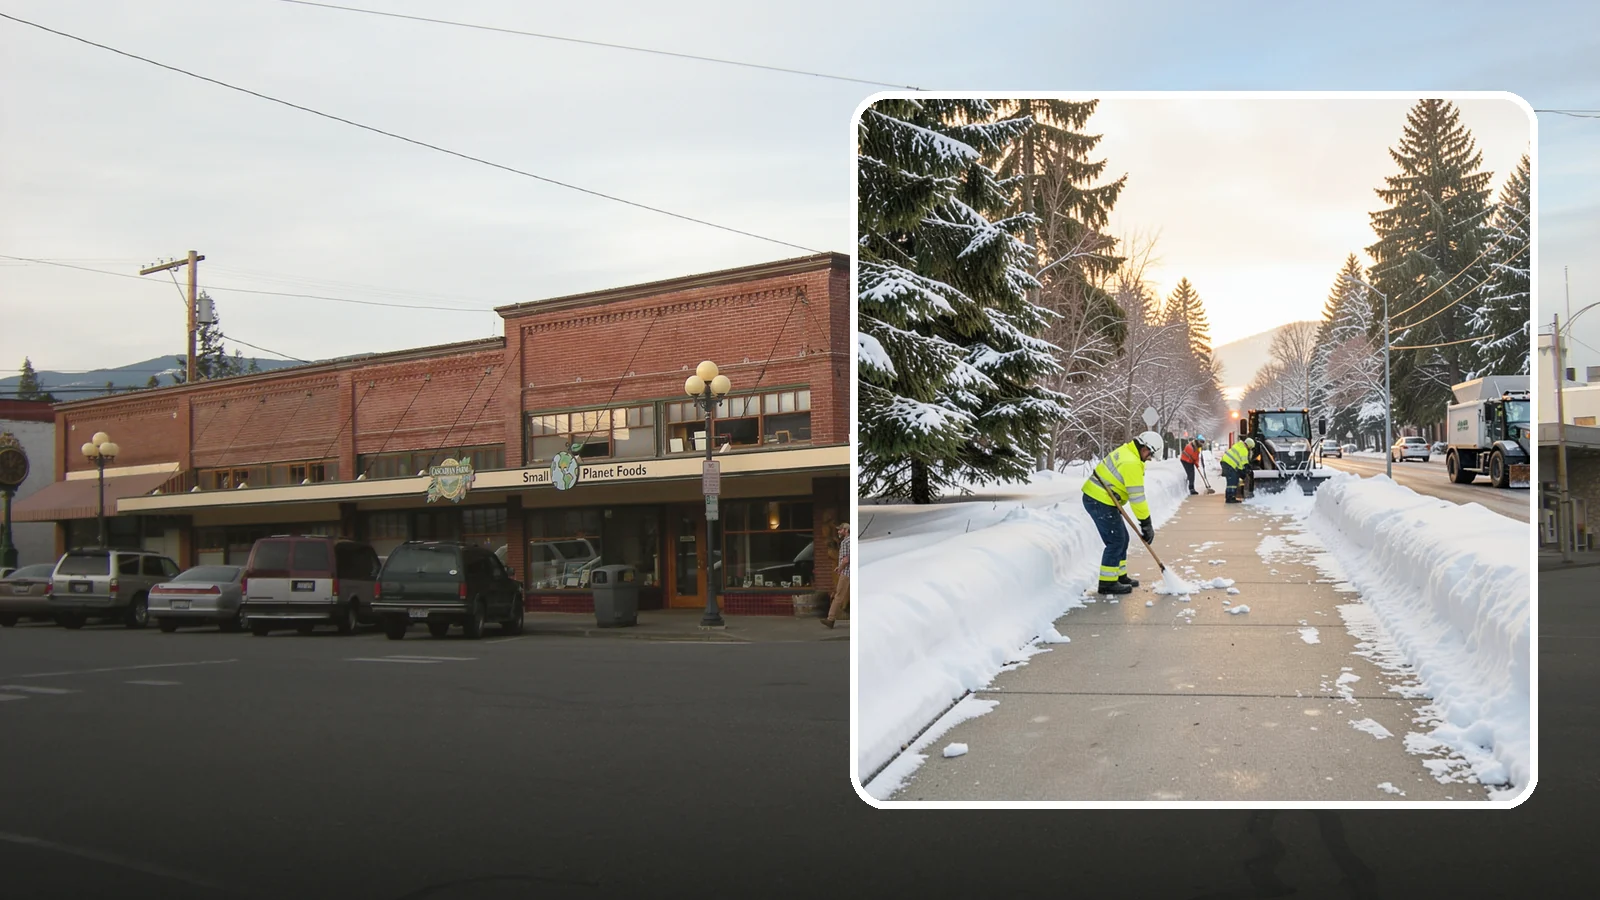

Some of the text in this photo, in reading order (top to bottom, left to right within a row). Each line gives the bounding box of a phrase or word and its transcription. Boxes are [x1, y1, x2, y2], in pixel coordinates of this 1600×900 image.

[522, 464, 647, 483] Small Planet Foods
